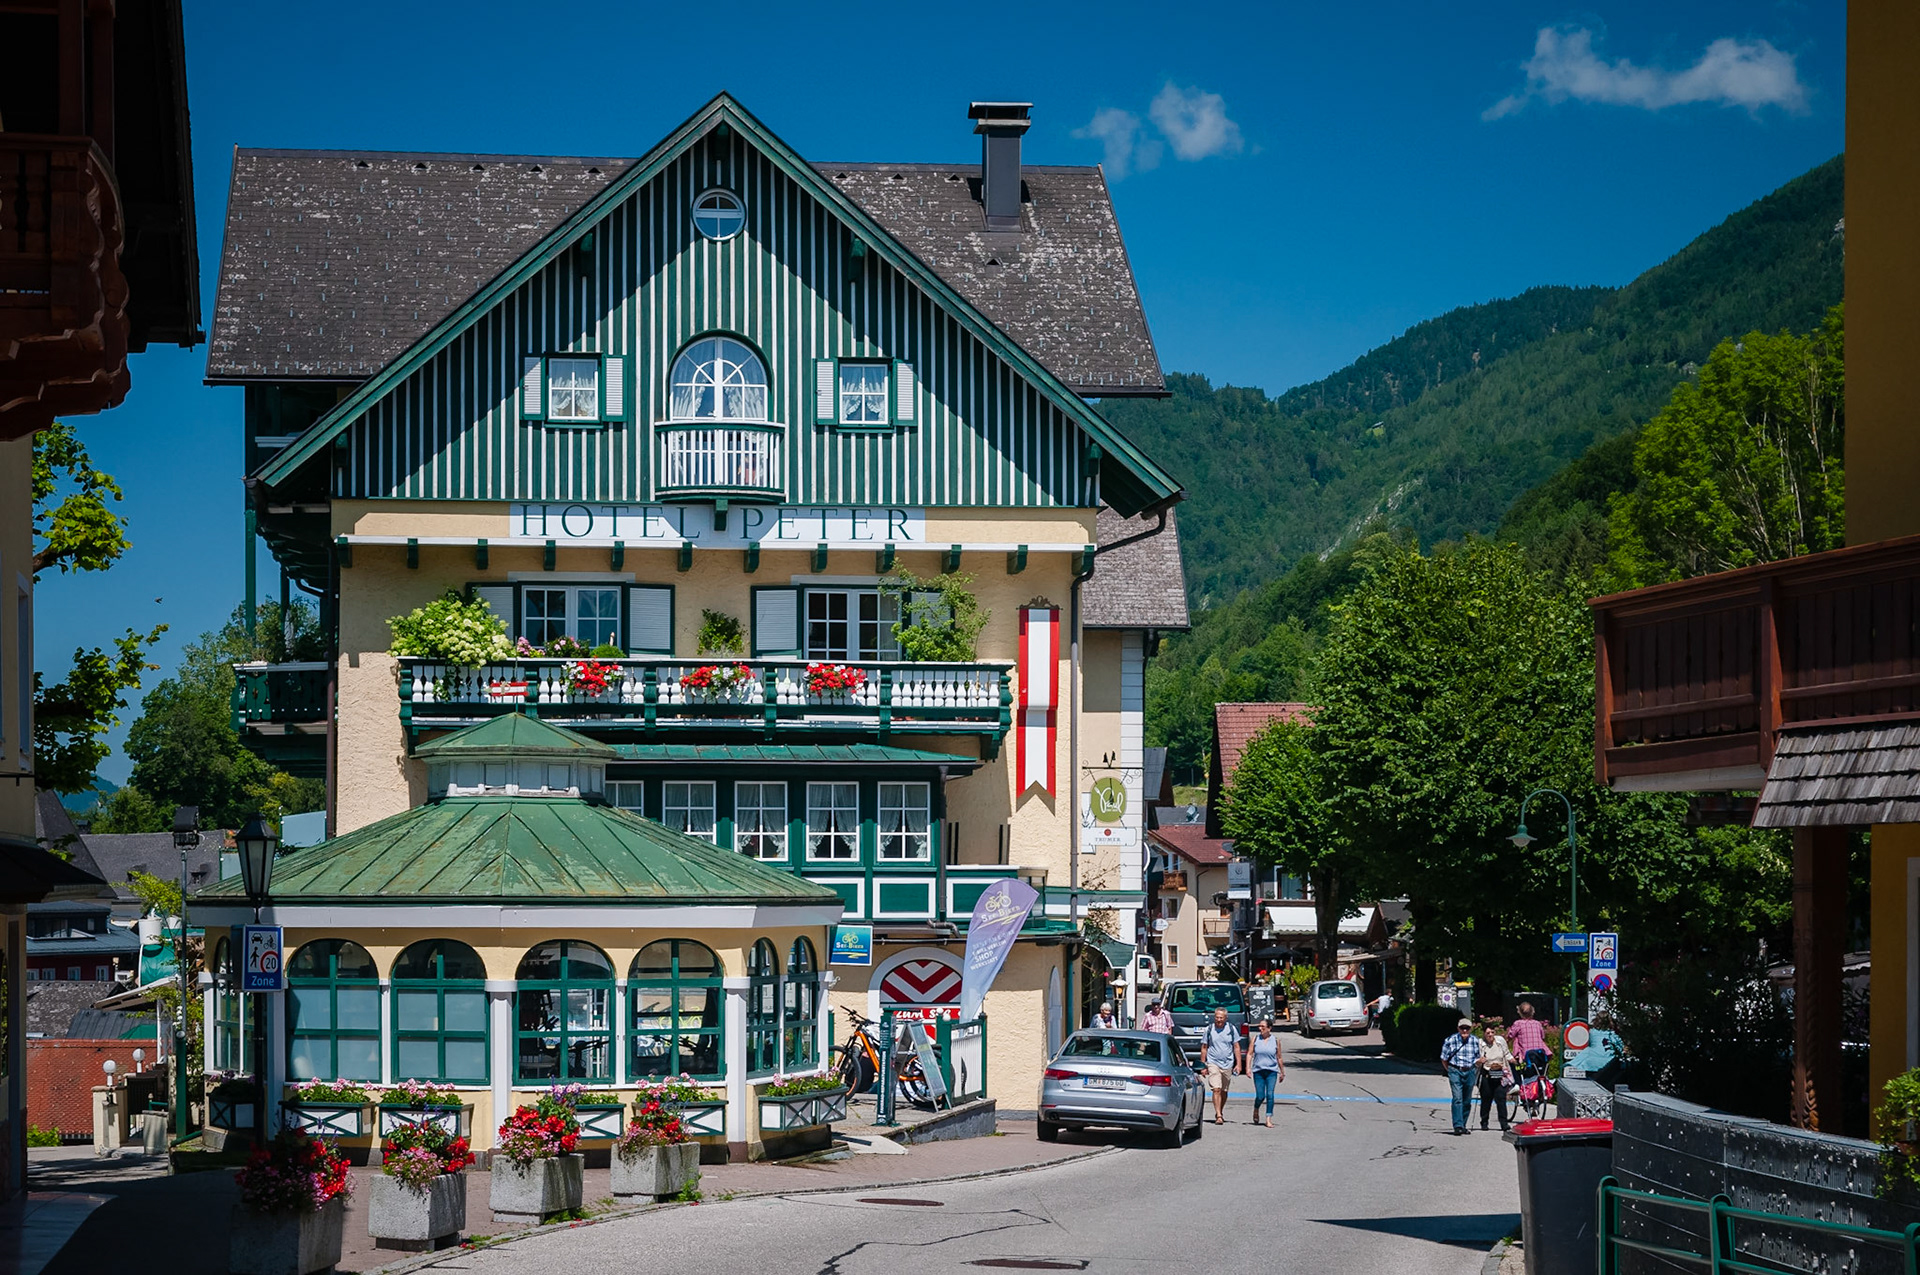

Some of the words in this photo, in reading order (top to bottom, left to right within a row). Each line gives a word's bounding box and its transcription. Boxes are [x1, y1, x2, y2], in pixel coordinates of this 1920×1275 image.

[520, 504, 701, 539] HOTEL
[740, 507, 914, 541] PETER
[973, 950, 994, 963] SHOP
[1604, 951, 1613, 959] 20
[265, 957, 277, 970] 20
[969, 956, 998, 971] WERKSTATT
[251, 975, 275, 987] Zone
